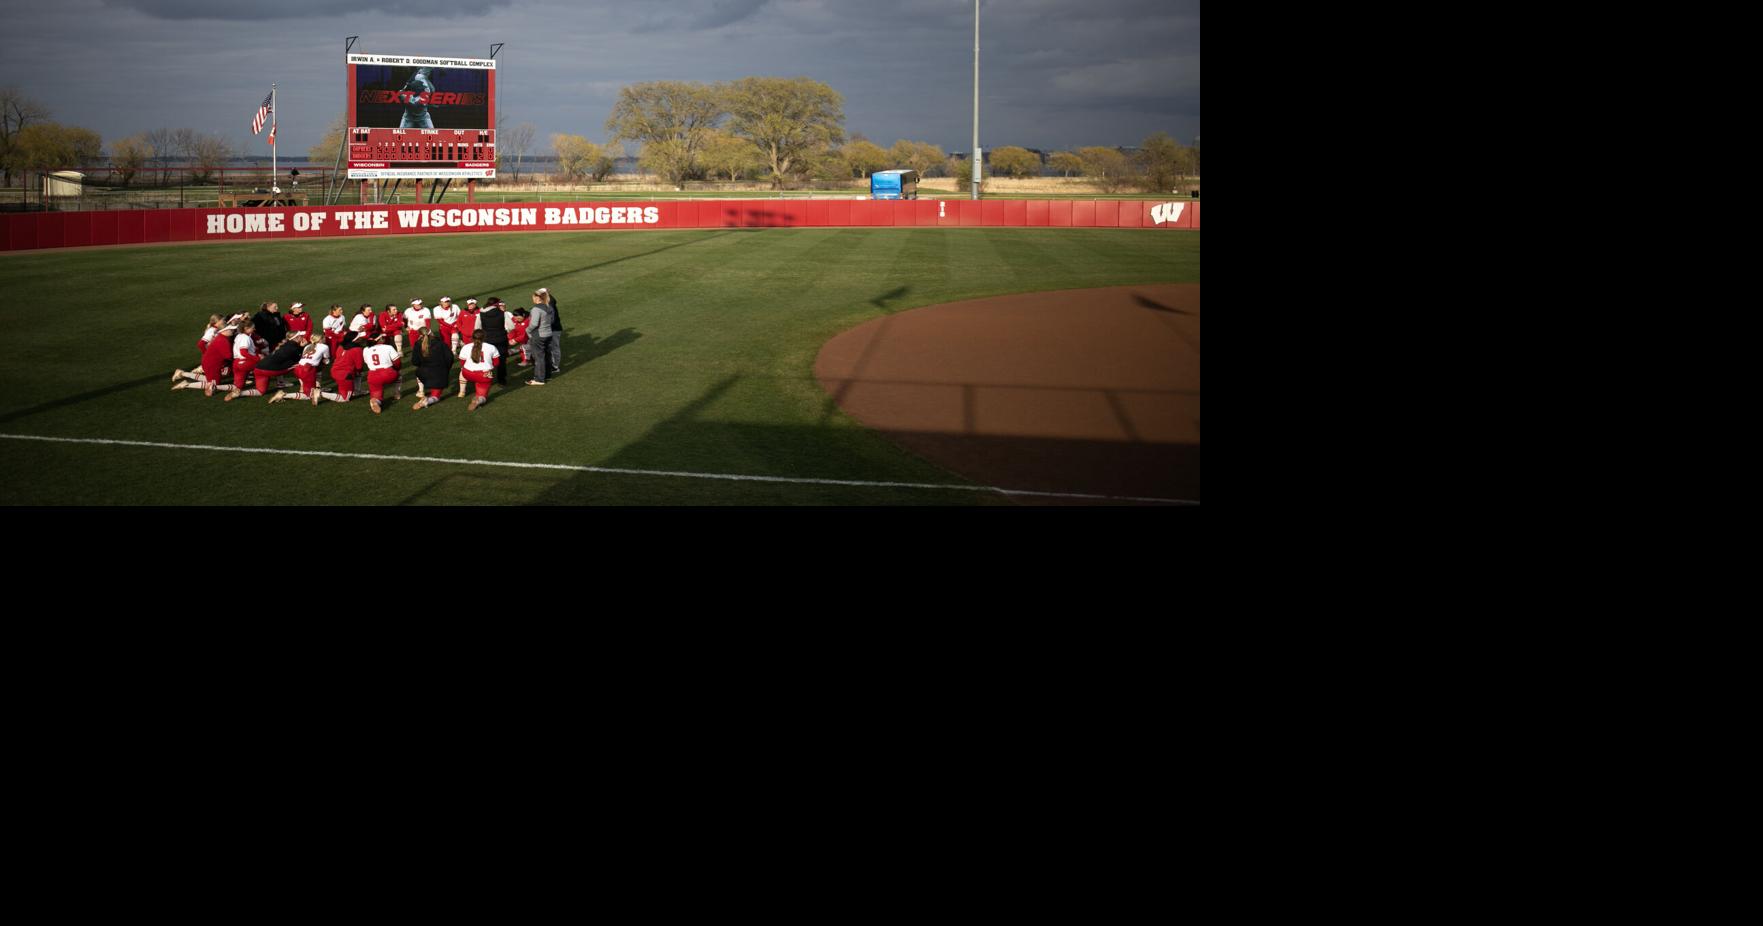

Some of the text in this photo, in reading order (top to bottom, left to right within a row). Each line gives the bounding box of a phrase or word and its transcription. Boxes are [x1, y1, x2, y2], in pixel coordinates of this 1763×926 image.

[360, 90, 485, 105] NEXT SERIES
[206, 206, 660, 234] HOME OF THE WISCONSIN BADGERS
[371, 353, 381, 366] 9
